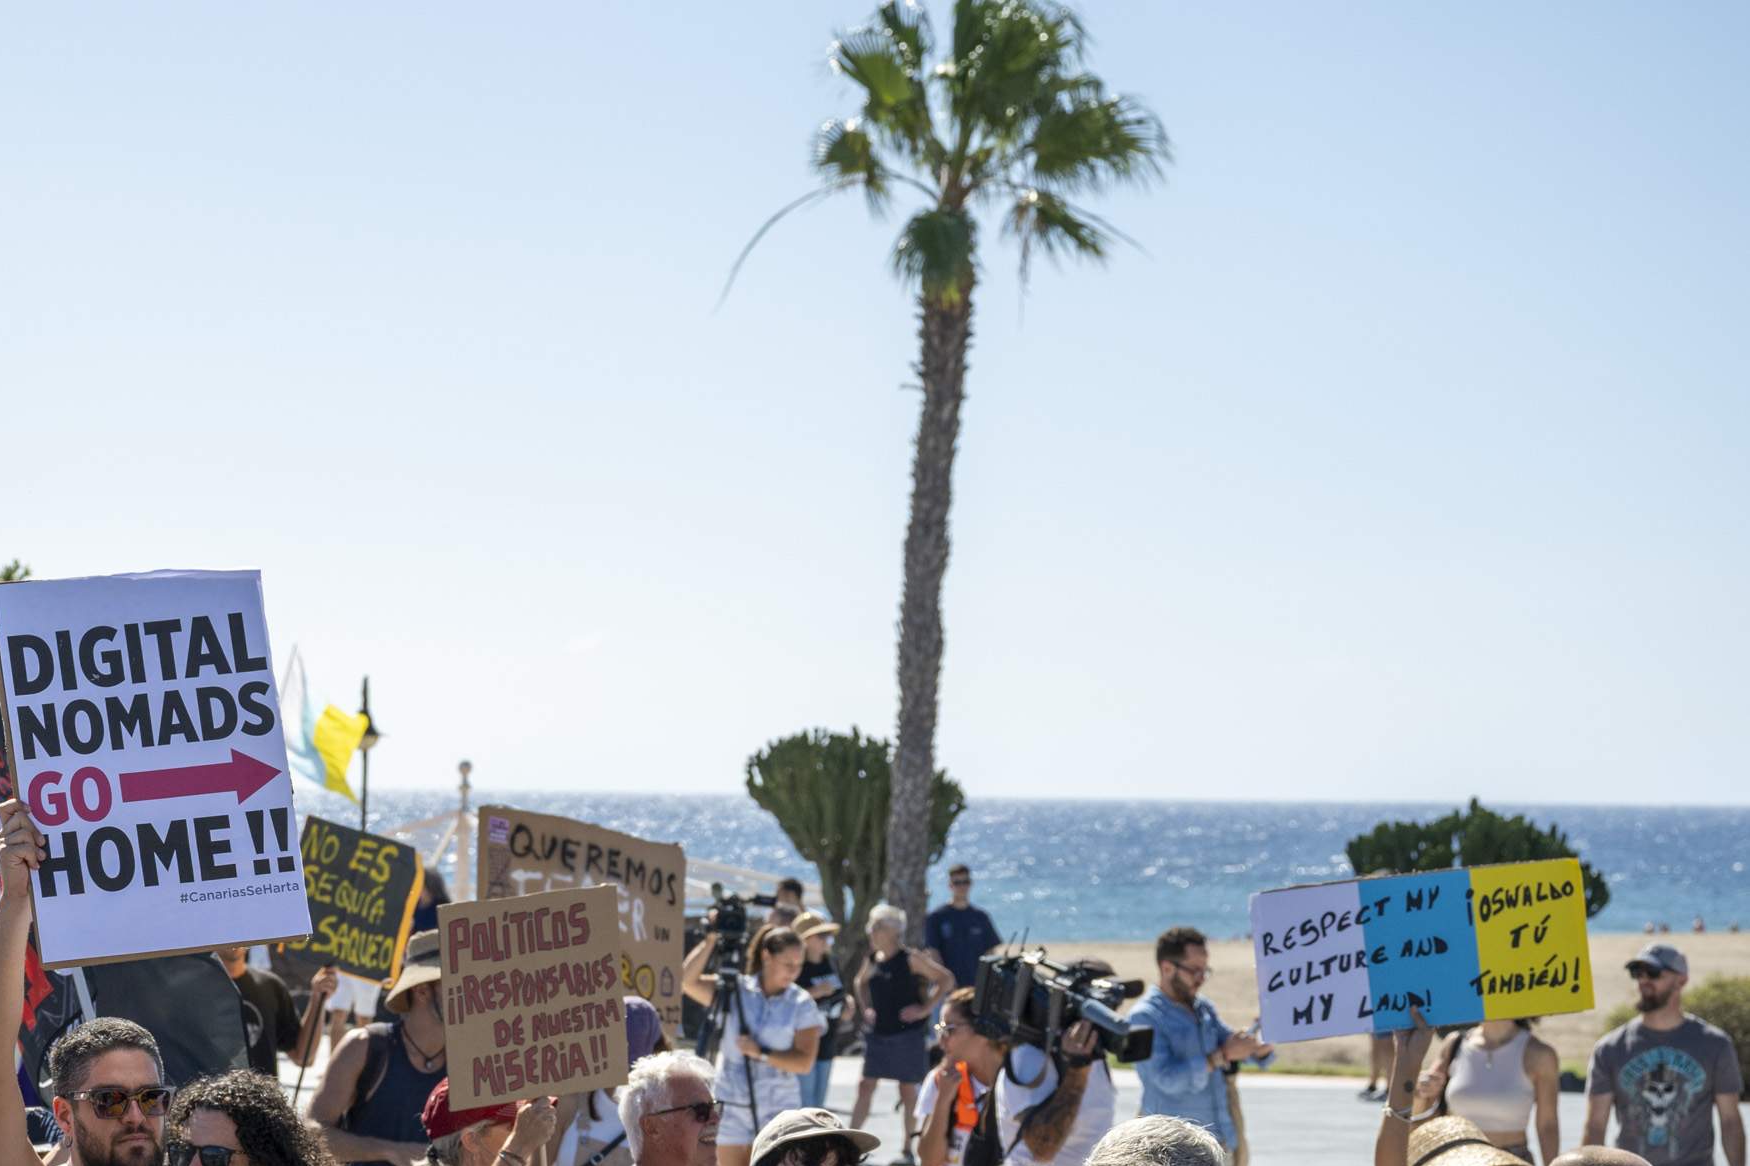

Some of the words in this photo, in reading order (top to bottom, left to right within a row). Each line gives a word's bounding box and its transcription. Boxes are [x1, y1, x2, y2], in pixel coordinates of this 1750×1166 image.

[7, 612, 268, 695] DIGITAL
[17, 681, 275, 760] NOMADS
[28, 766, 112, 827] GO
[302, 824, 340, 864] NO
[349, 839, 399, 883] ES
[509, 823, 677, 906] QUEREMOS
[179, 881, 300, 903] #CanariasSeHarta
[311, 915, 395, 970] SAQUEO
[1262, 897, 1392, 958] RESPECT
[1406, 885, 1441, 913] MY
[1510, 914, 1552, 949] TÚ
[1267, 944, 1388, 993] CULTURE
[1400, 935, 1450, 959] AND
[493, 1015, 525, 1048] DE
[532, 998, 621, 1043] NUESTRA
[1292, 992, 1334, 1027] MY
